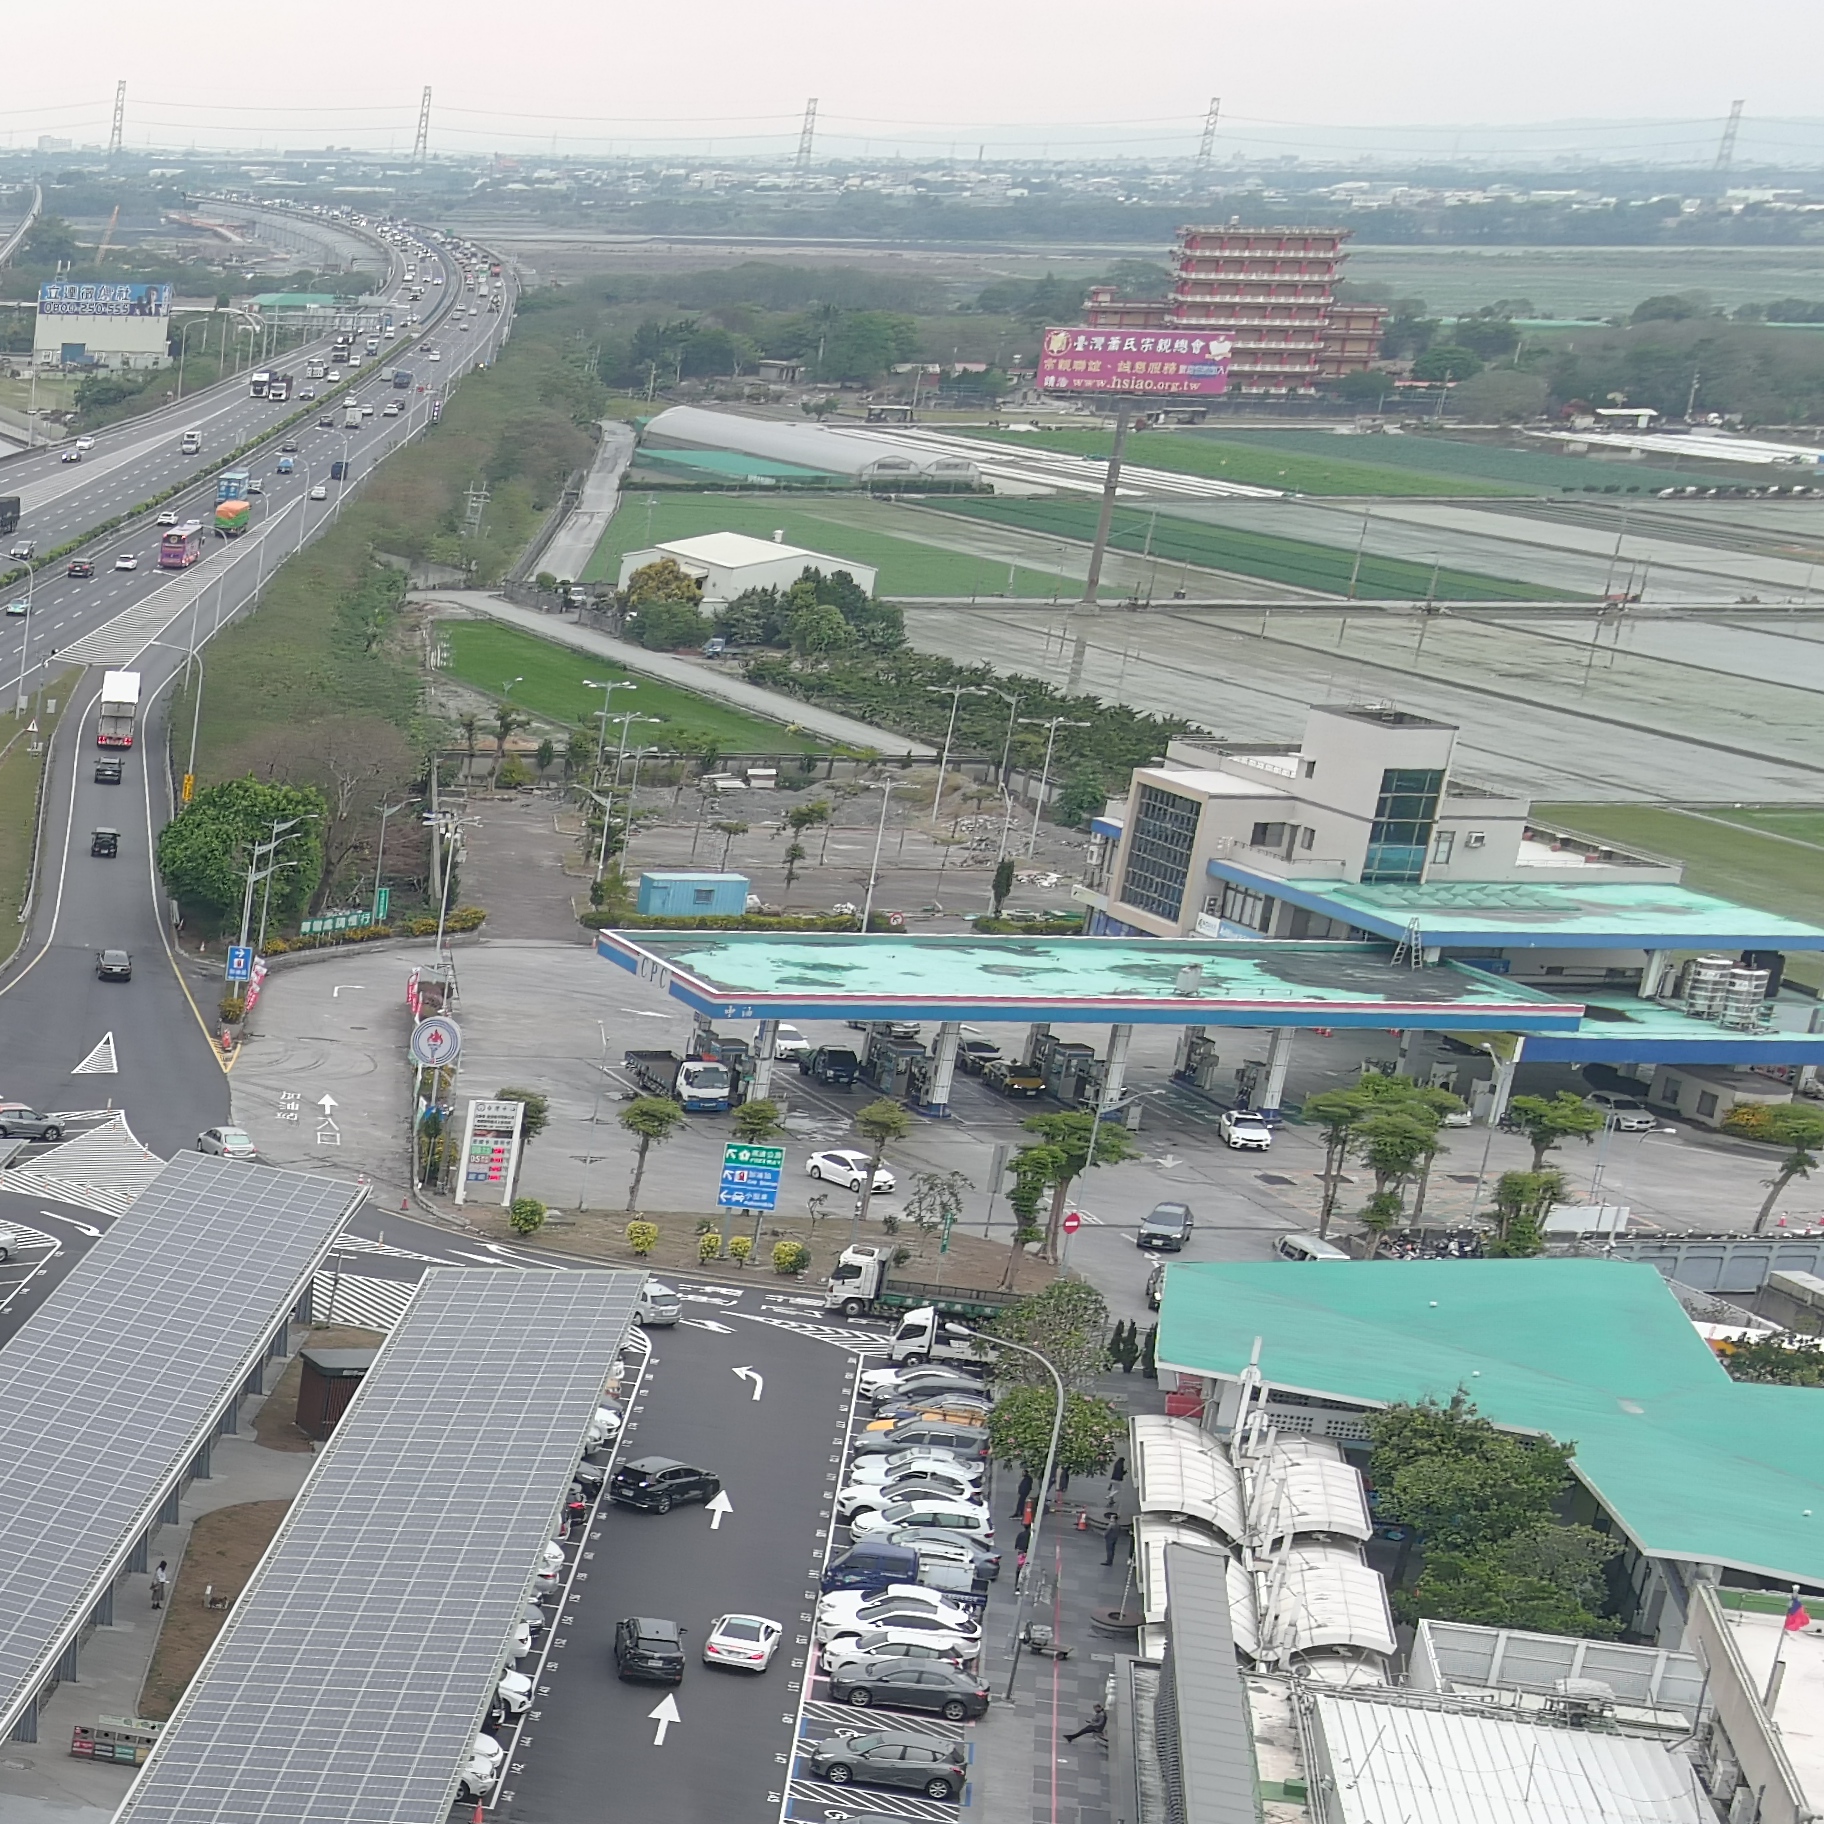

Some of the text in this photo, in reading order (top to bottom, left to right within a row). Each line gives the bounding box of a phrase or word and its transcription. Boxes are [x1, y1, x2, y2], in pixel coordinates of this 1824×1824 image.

[1072, 376, 1202, 393] www.hsiao.org.tw
[641, 957, 667, 989] CPC
[316, 1116, 341, 1146] 入口
